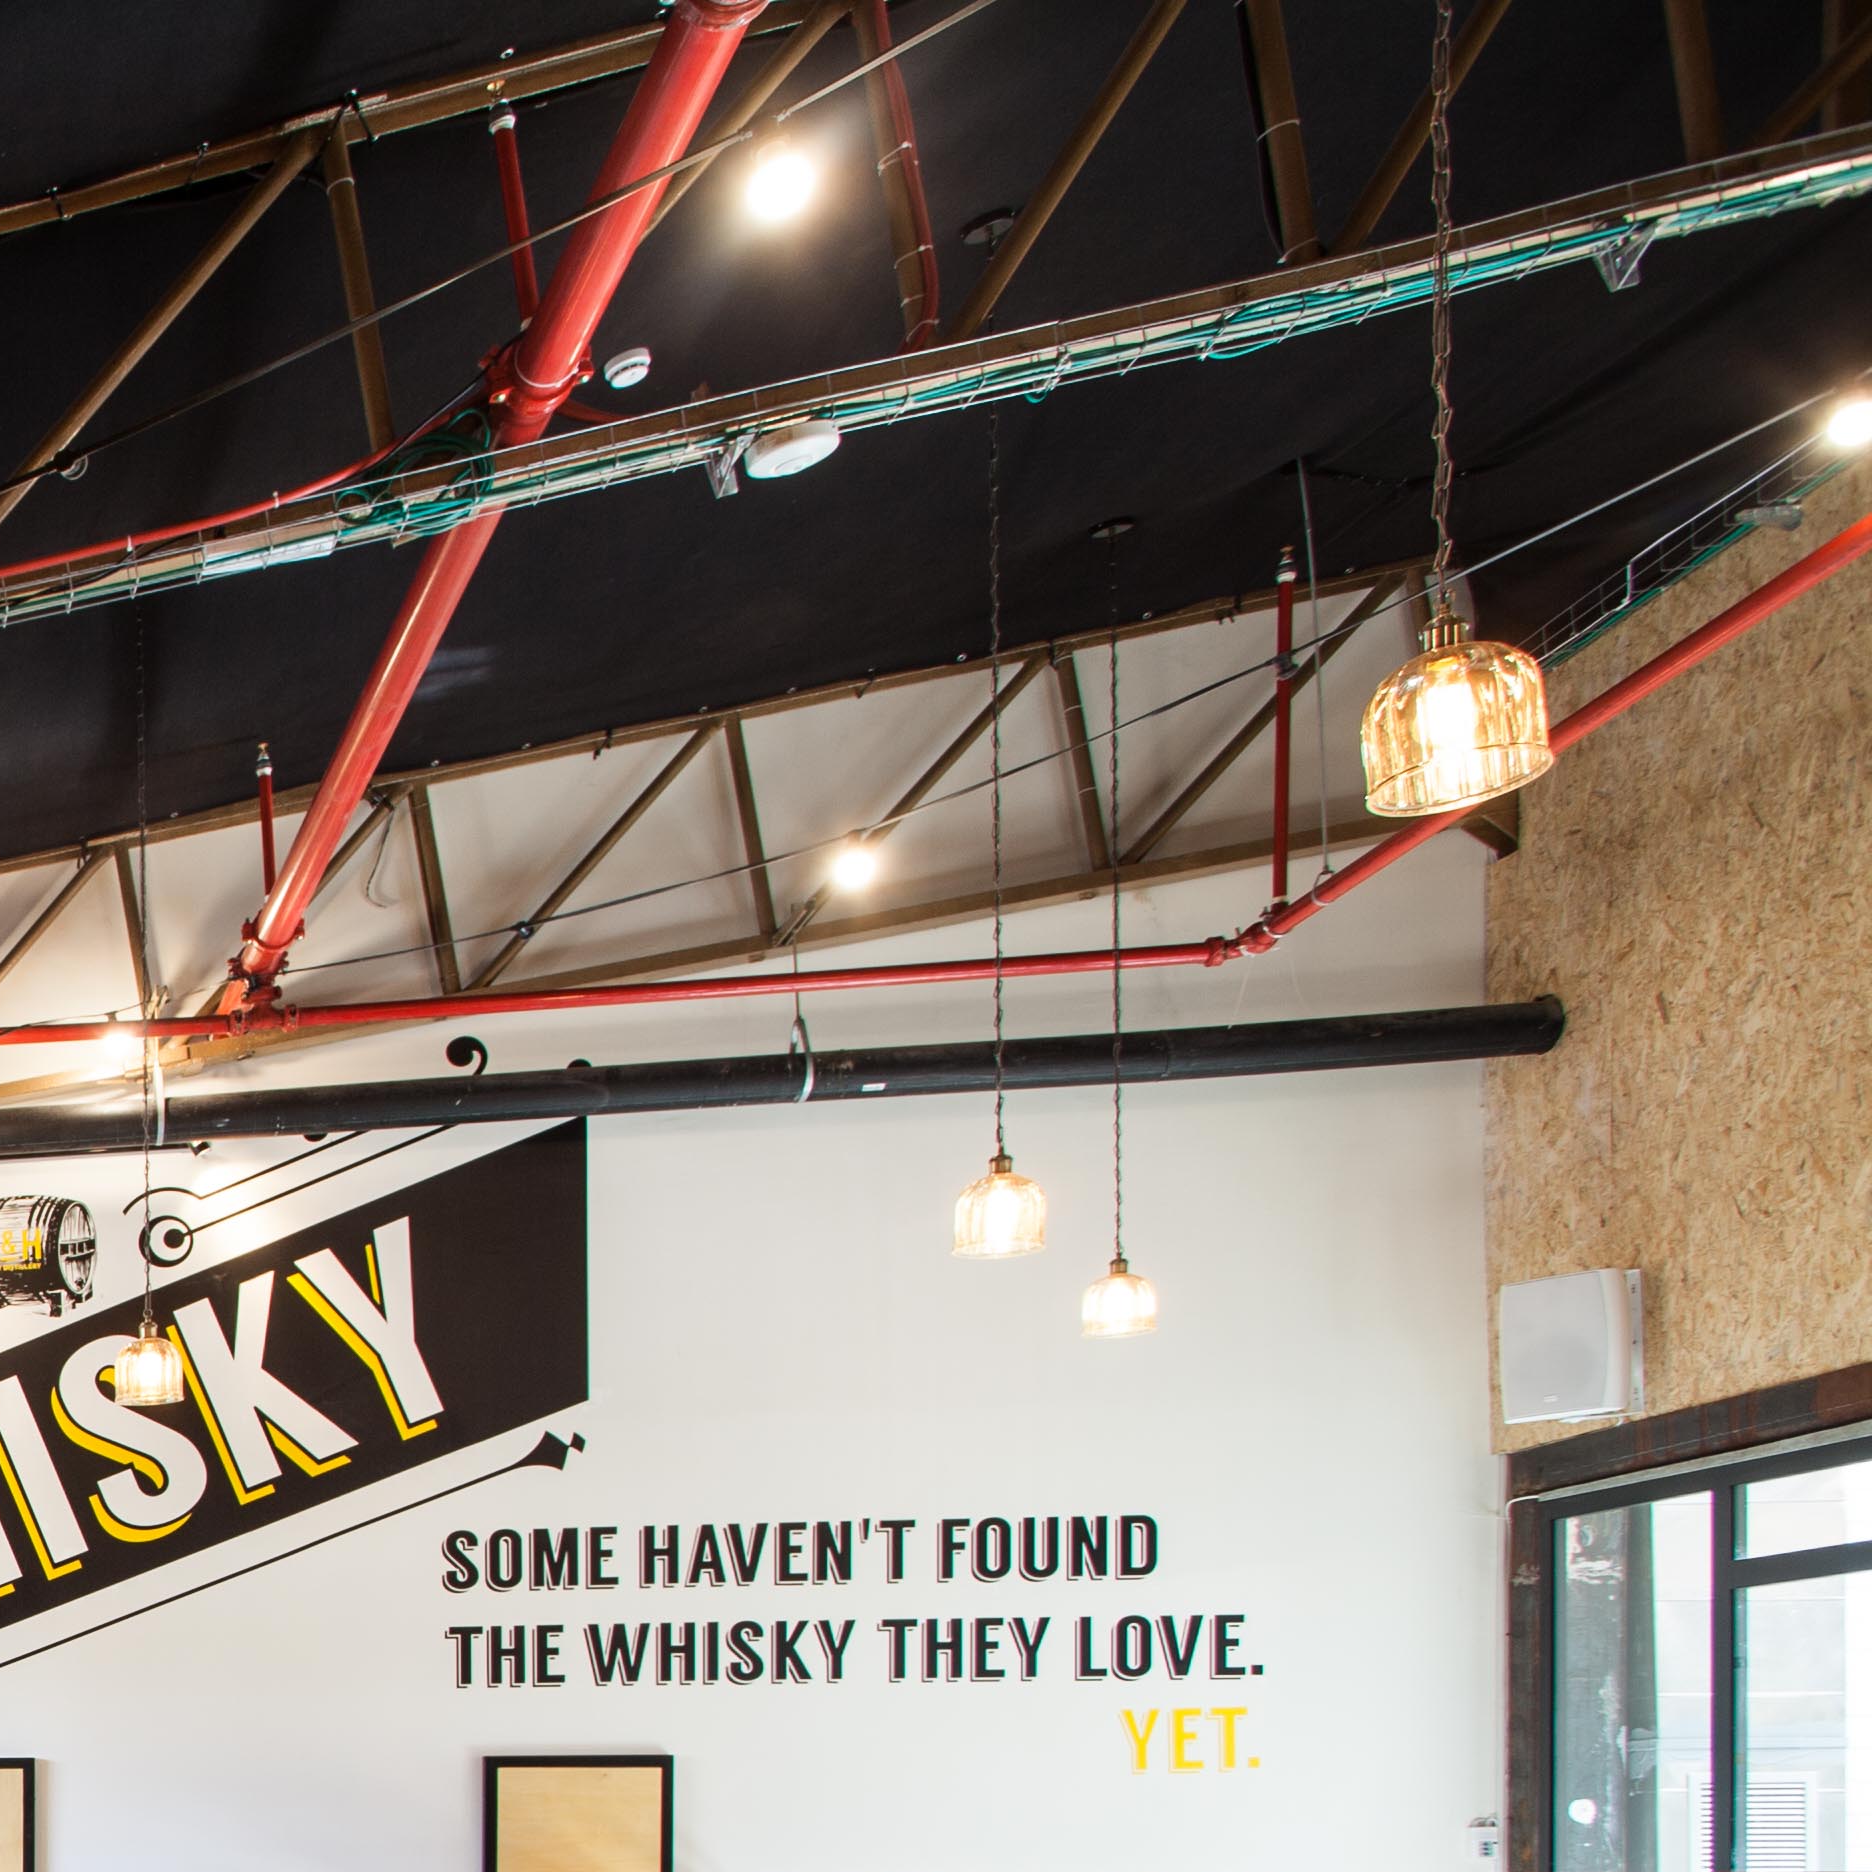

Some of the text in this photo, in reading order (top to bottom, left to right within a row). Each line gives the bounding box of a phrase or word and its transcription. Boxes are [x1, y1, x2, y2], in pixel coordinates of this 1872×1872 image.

[441, 1513, 1159, 1593] SOME HAVEN'T FOUND
[445, 1612, 1264, 1688] THE WHISKY THEY LOVE.
[1118, 1705, 1262, 1774] YET.
